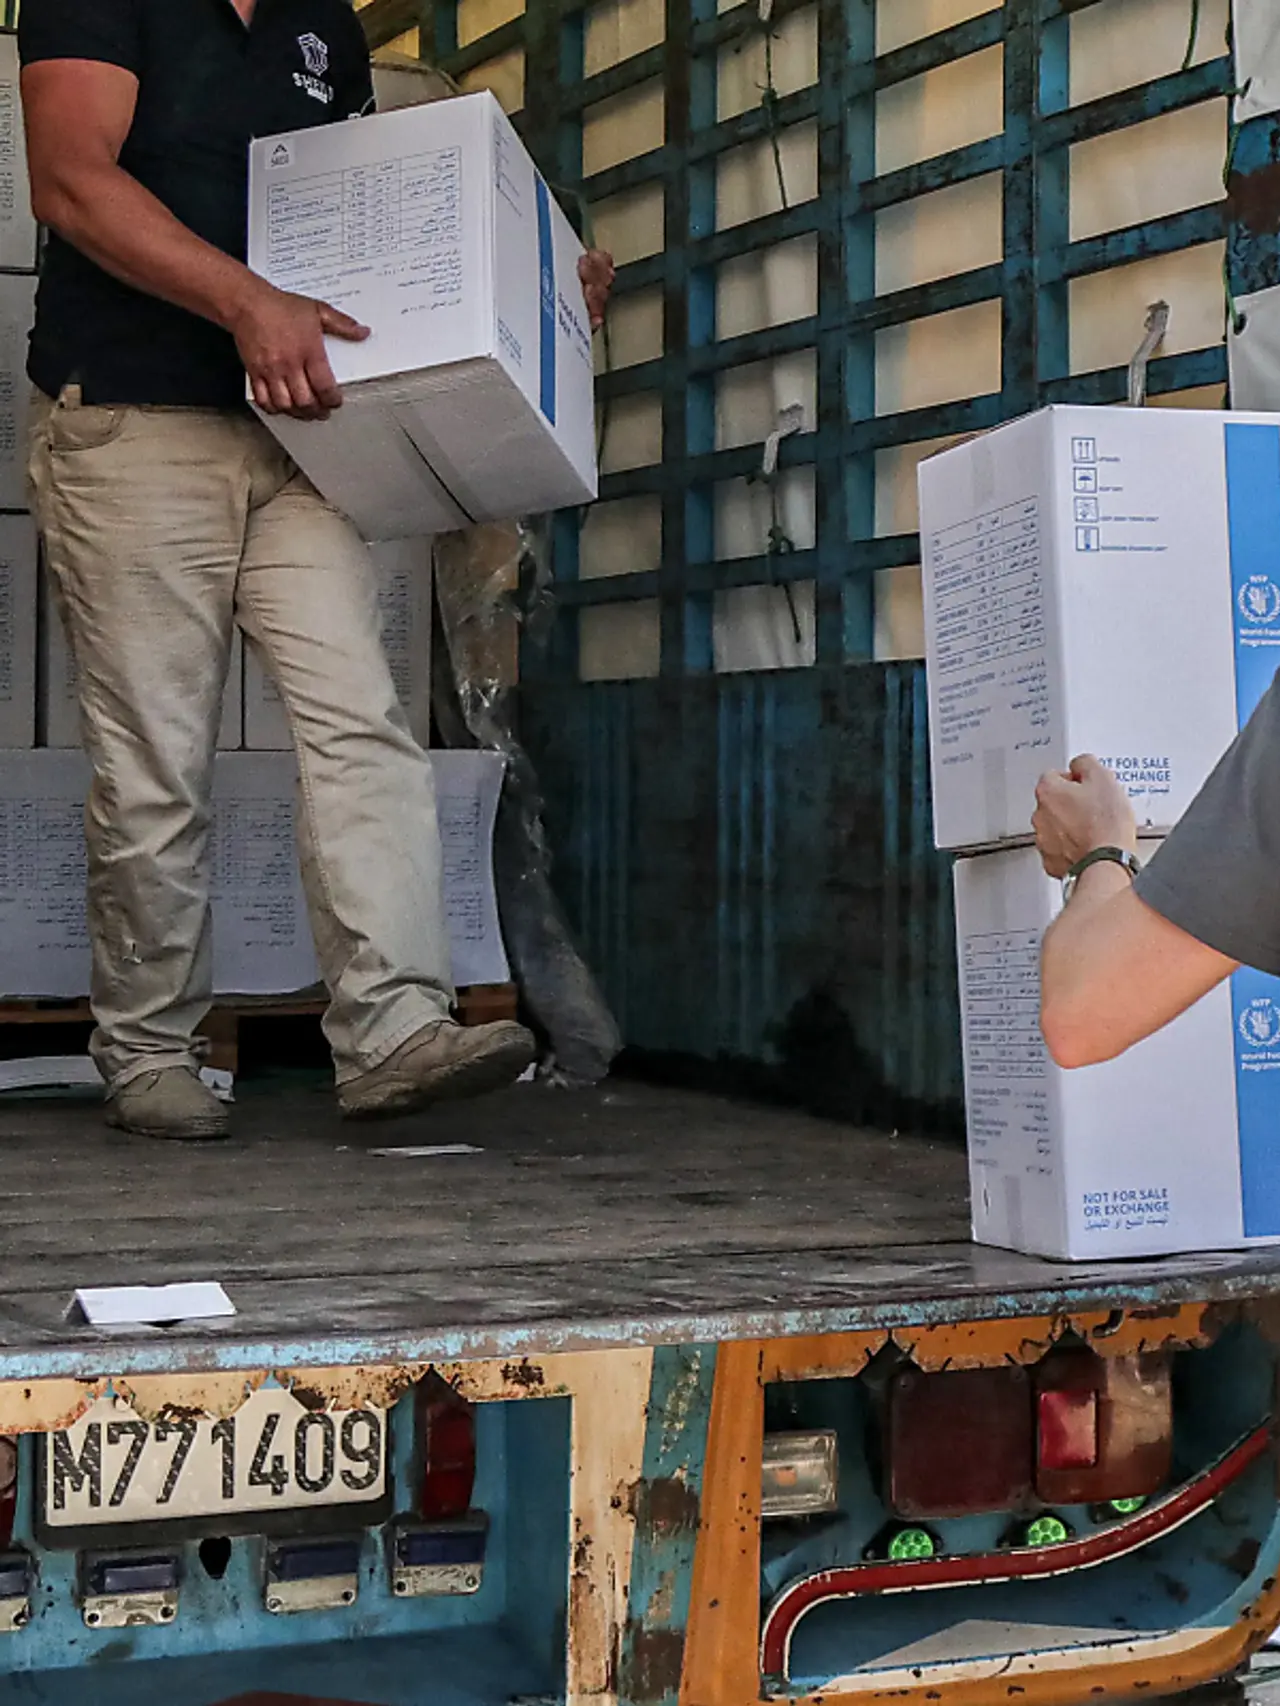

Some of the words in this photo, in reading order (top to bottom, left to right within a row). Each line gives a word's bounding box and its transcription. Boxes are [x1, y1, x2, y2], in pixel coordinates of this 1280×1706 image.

[1116, 757, 1140, 769] FOR
[1142, 757, 1170, 769] SALE
[1083, 1192, 1109, 1204] NOT
[1113, 1189, 1137, 1202] FOR
[1139, 1187, 1168, 1200] SALE
[1083, 1205, 1102, 1217] OR
[1105, 1201, 1170, 1215] EXCHANGE
[53, 1410, 381, 1509] M771409
